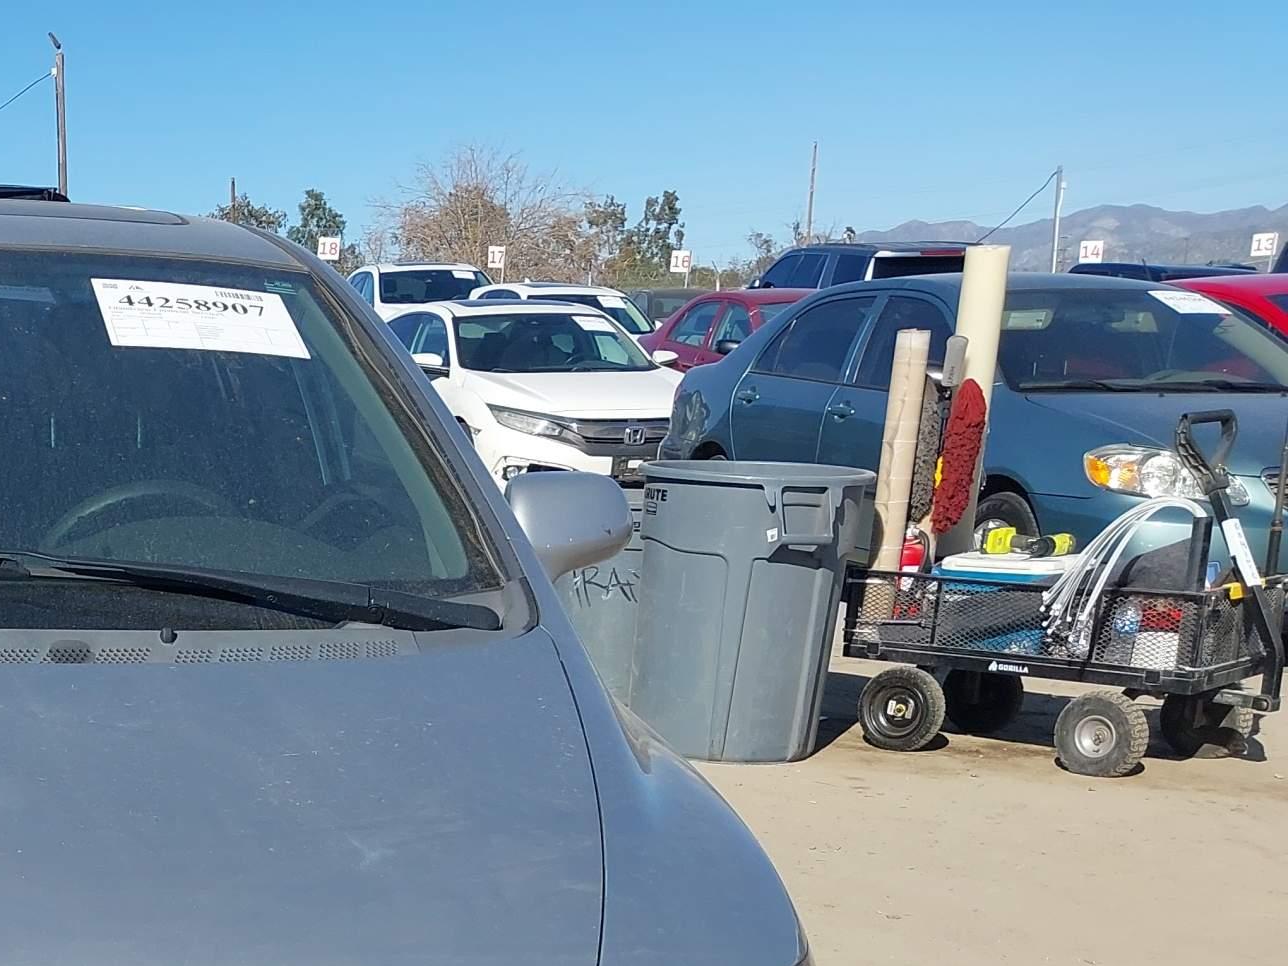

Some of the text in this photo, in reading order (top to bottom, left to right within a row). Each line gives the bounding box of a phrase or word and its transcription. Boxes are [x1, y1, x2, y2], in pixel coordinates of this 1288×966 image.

[319, 242, 338, 255] 18
[1081, 244, 1100, 259] 14
[1254, 237, 1275, 252] 13
[489, 250, 504, 264] 17
[118, 294, 264, 317] 44258907
[998, 663, 1029, 673] GORILLA
